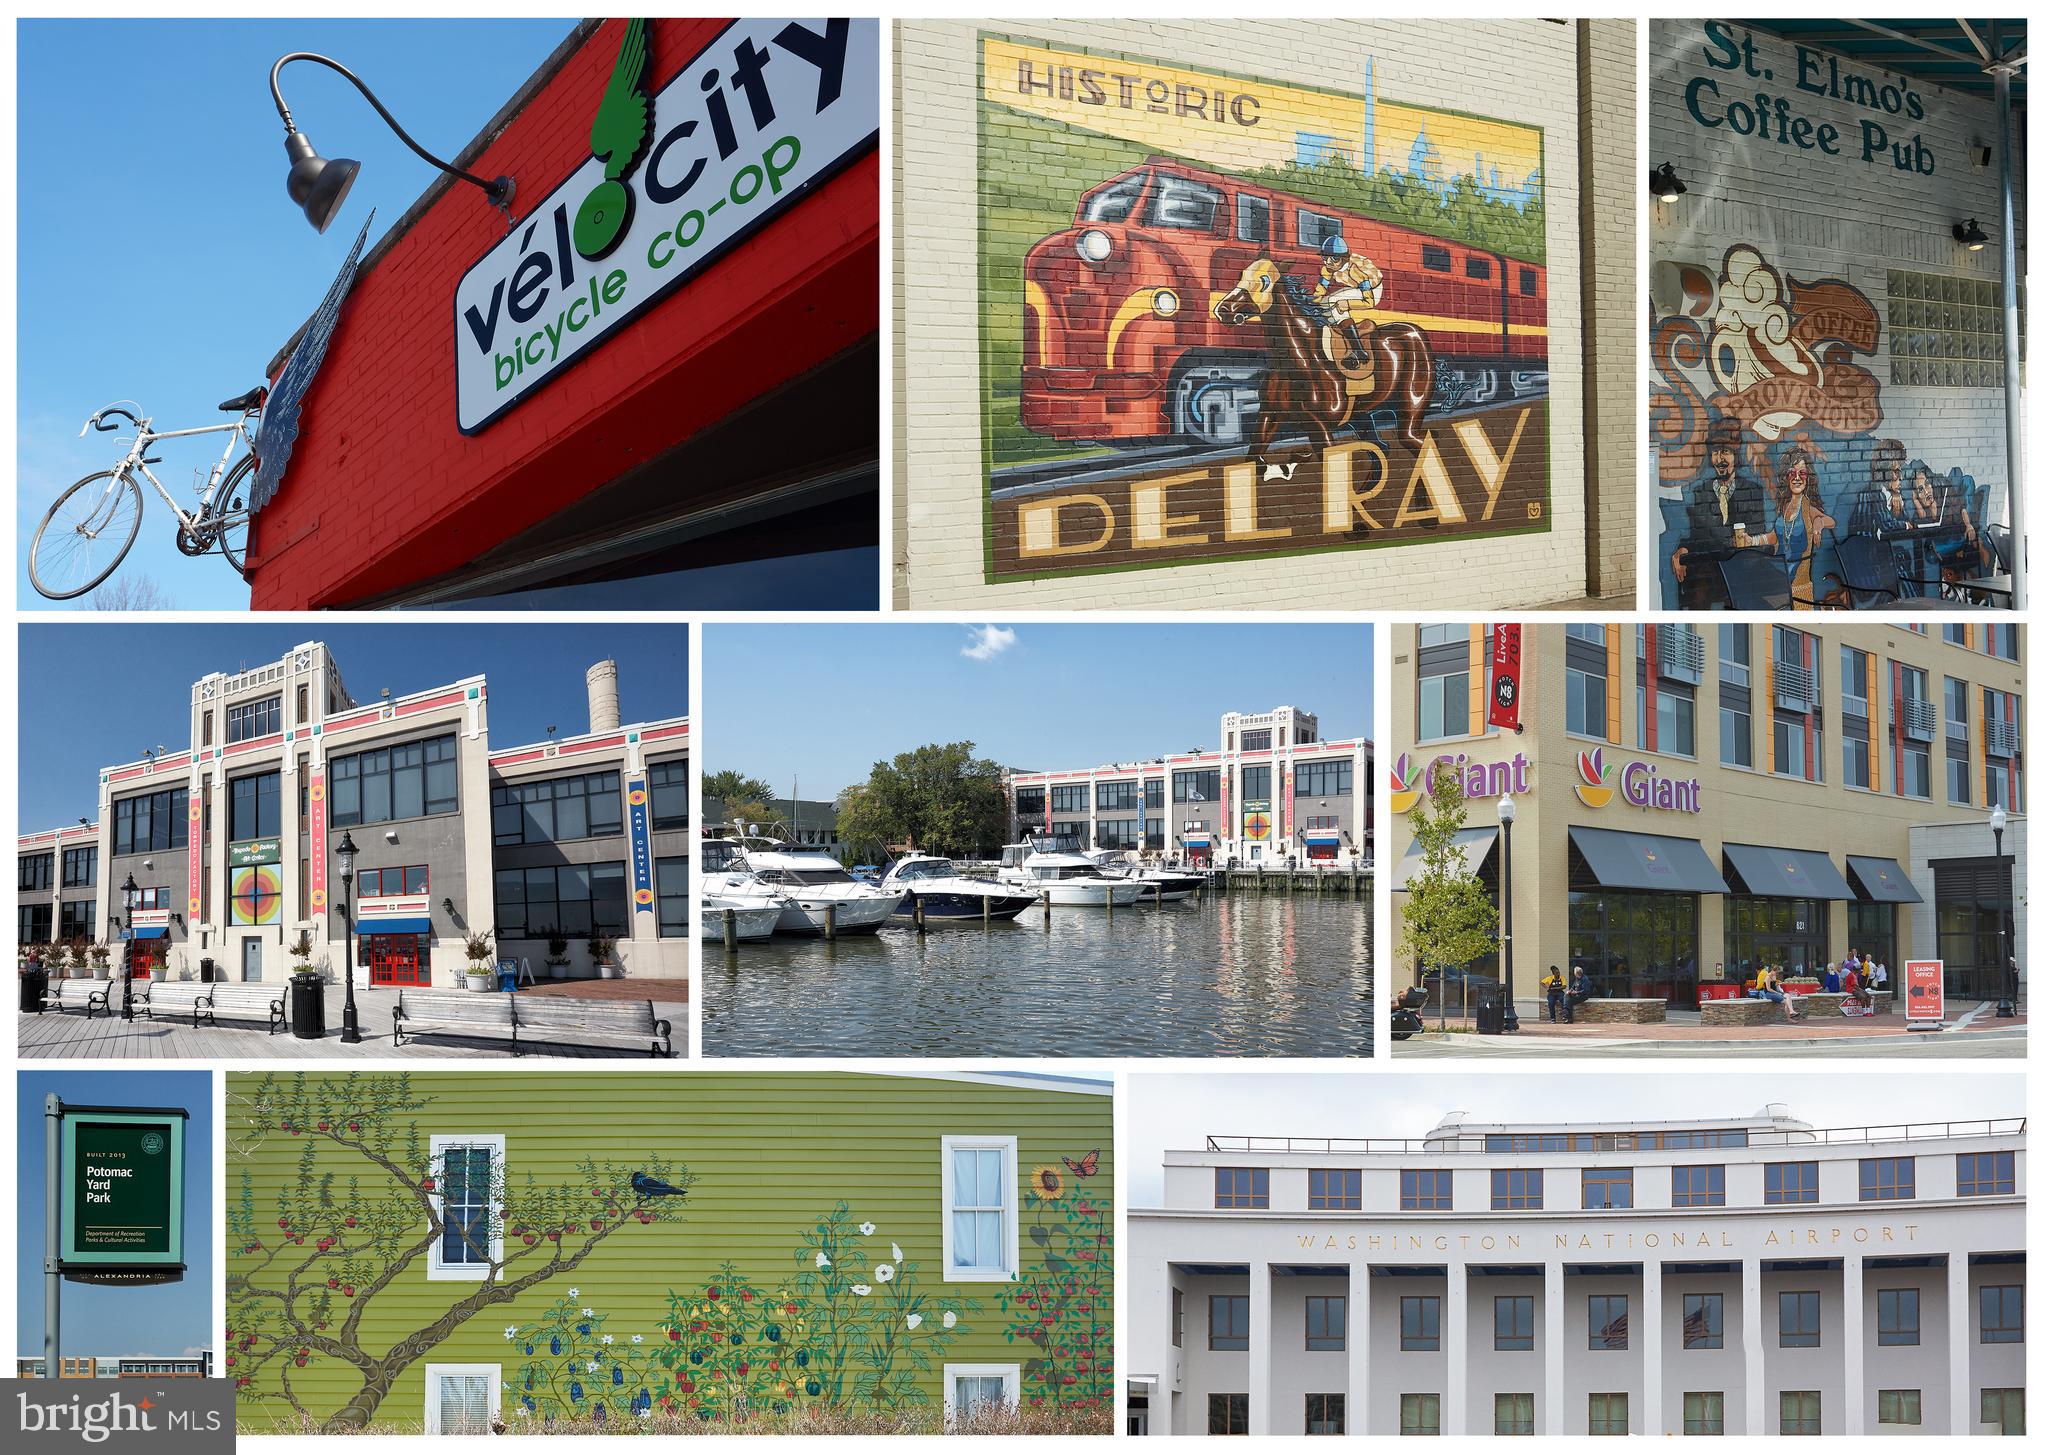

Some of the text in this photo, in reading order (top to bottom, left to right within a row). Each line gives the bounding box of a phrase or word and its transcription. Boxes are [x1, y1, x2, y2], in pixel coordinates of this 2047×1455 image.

[1018, 58, 1261, 128] HISTORIC
[1703, 20, 1925, 121] St. Elmo's
[1685, 76, 1936, 177] Coffee Pub
[496, 135, 802, 391] bicycle co-op
[1801, 310, 1875, 345] COFFEE
[1726, 378, 1876, 430] PROVISIONS
[1018, 407, 1531, 559] DEL RAY
[1500, 684, 1512, 699] N8
[1620, 761, 1701, 814] Giant
[635, 811, 646, 882] ART CENTER
[86, 1166, 133, 1177] Potomac
[86, 1179, 111, 1190] Yard
[86, 1192, 111, 1203] Park
[1297, 1224, 1919, 1250] WASHINGTON NATIONAL AIRPORT
